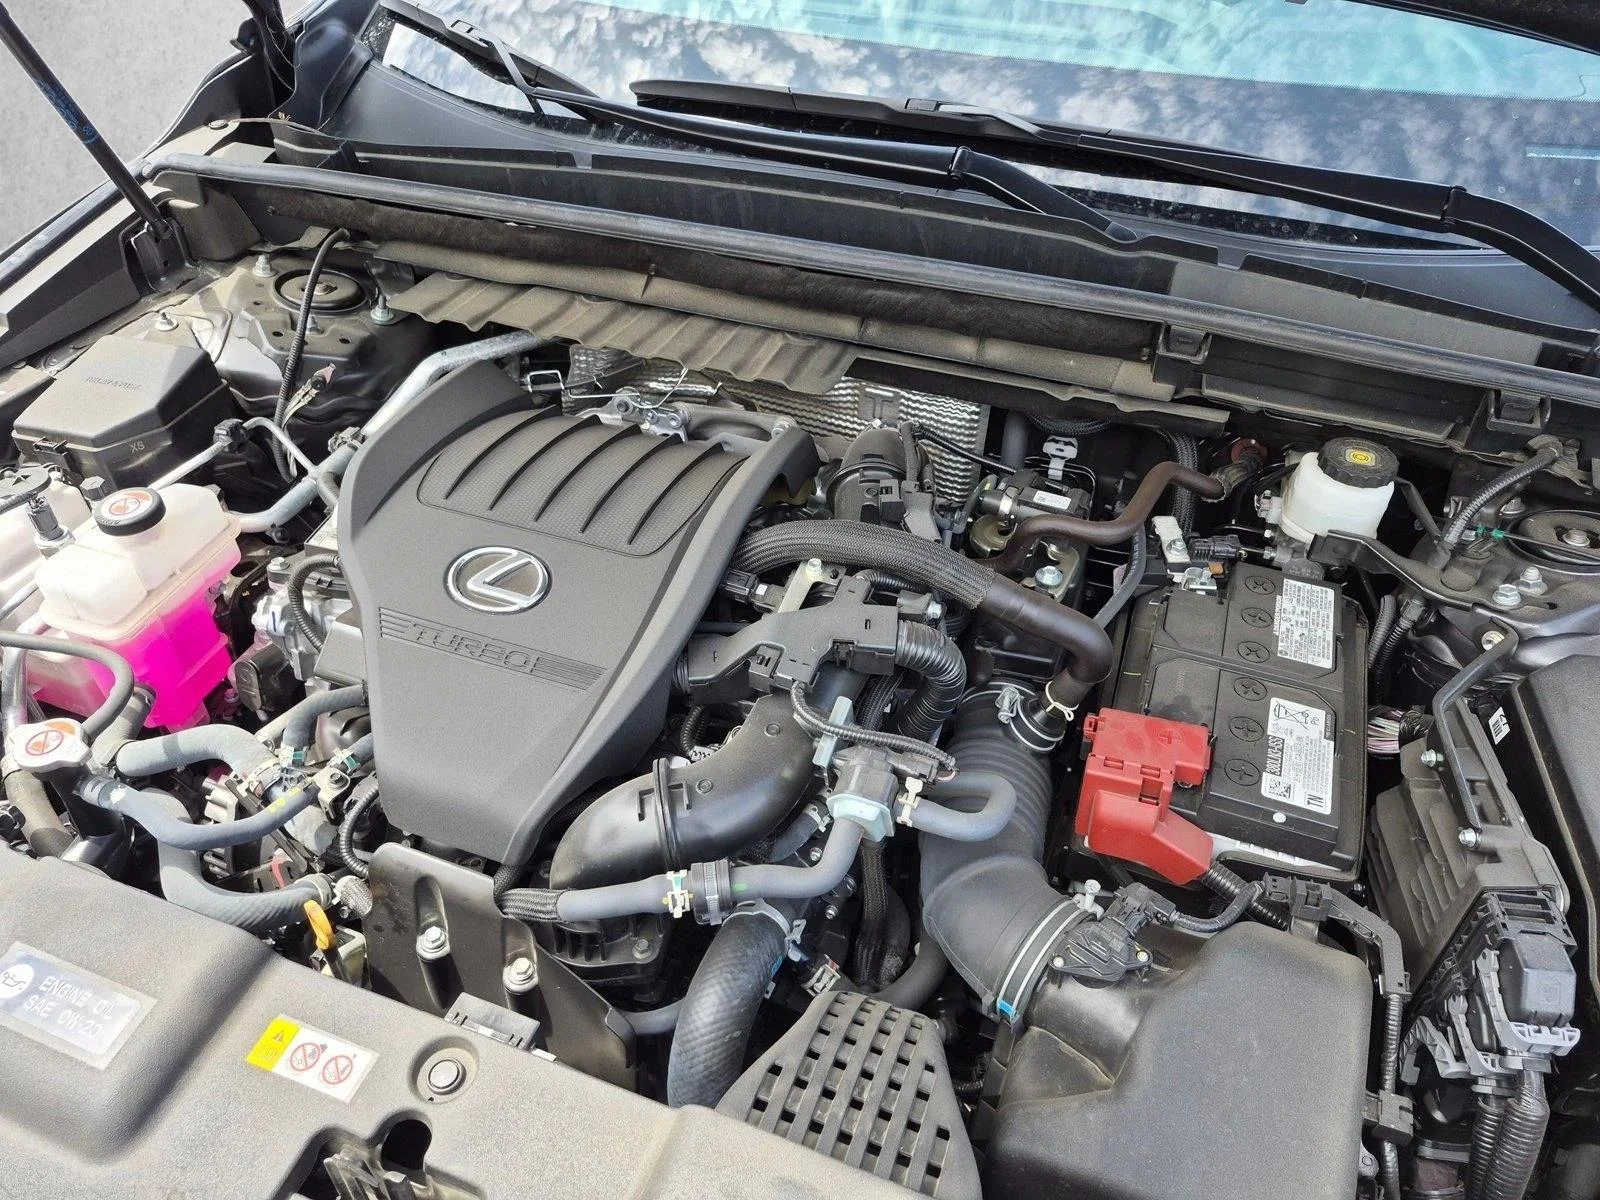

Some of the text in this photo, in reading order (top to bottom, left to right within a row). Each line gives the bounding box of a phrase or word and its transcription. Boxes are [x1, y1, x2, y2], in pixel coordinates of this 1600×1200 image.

[413, 622, 532, 668] TURBO
[1307, 793, 1324, 808] TN
[24, 994, 58, 1018] SAE
[38, 975, 114, 1020] ENGINE OIL
